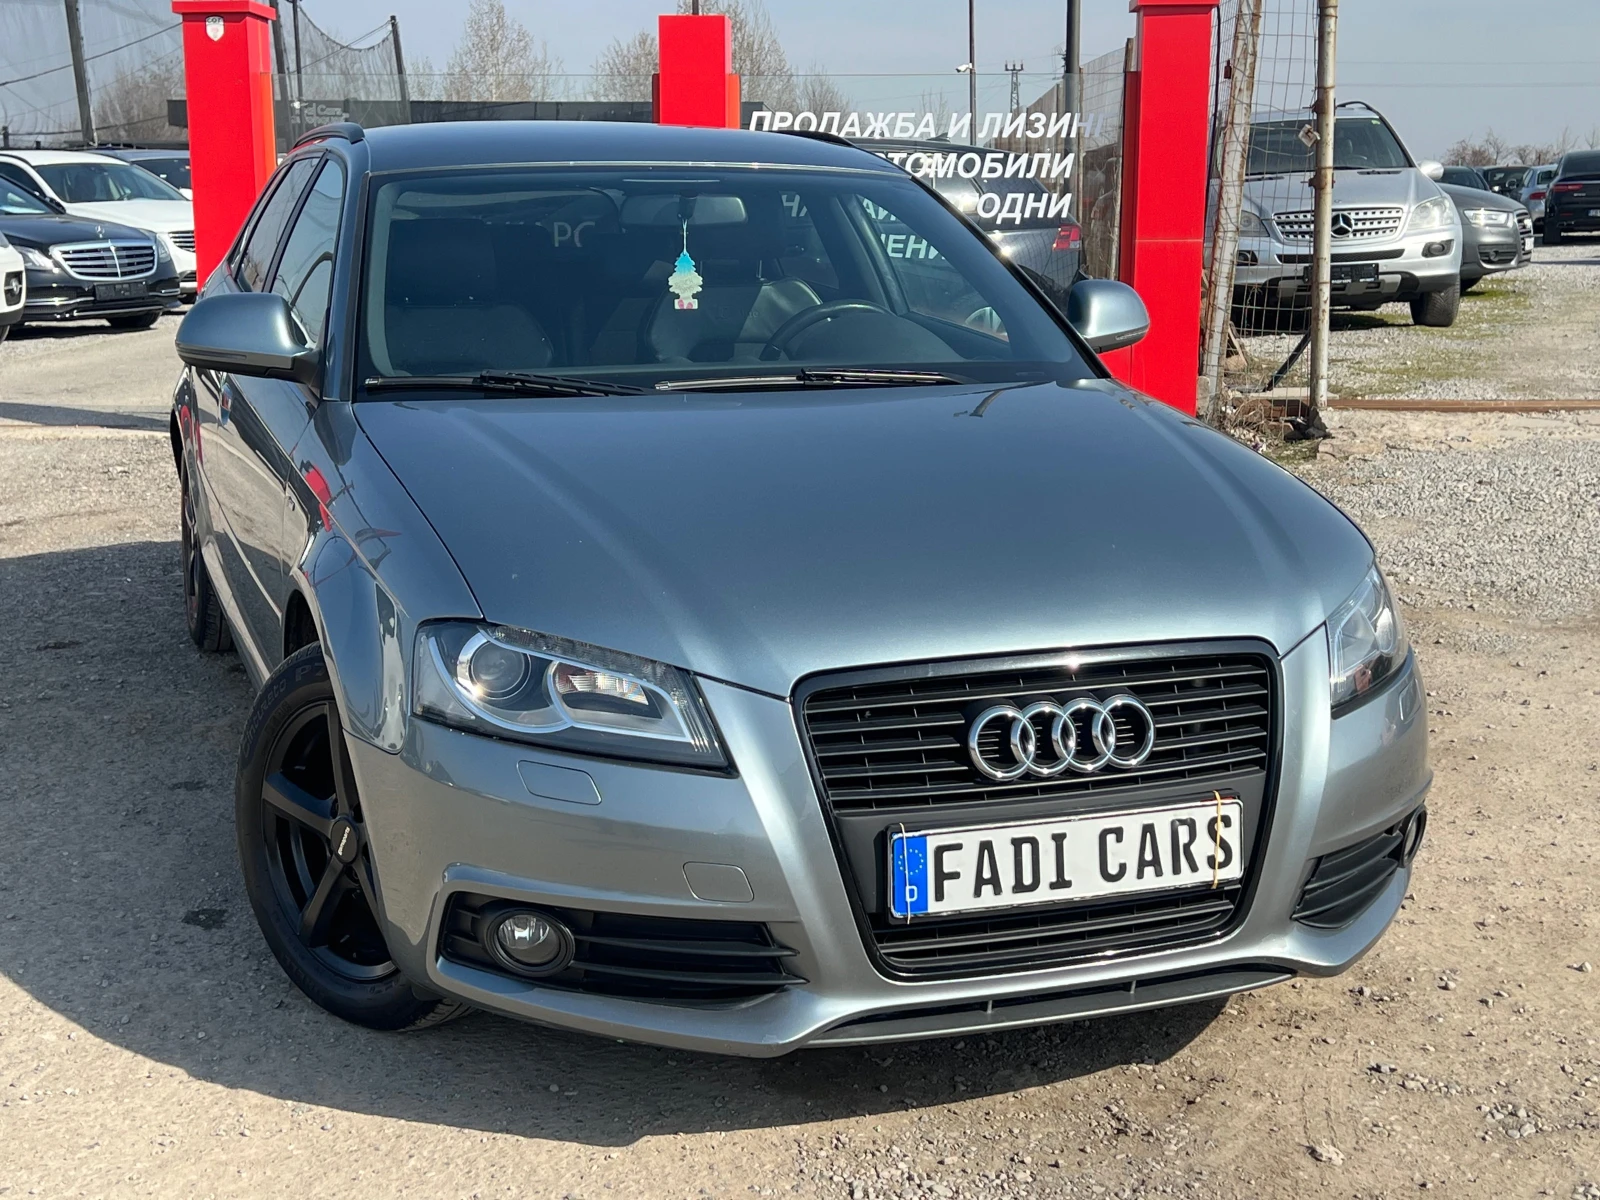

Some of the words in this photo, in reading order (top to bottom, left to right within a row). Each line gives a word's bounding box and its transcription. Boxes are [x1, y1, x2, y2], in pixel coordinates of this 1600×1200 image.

[748, 110, 936, 139] ПРОДАЖБА
[947, 111, 973, 139] И
[874, 152, 1075, 179] ТОМОБИЛИ
[933, 832, 1073, 902] FADI
[1099, 814, 1233, 883] CARS
